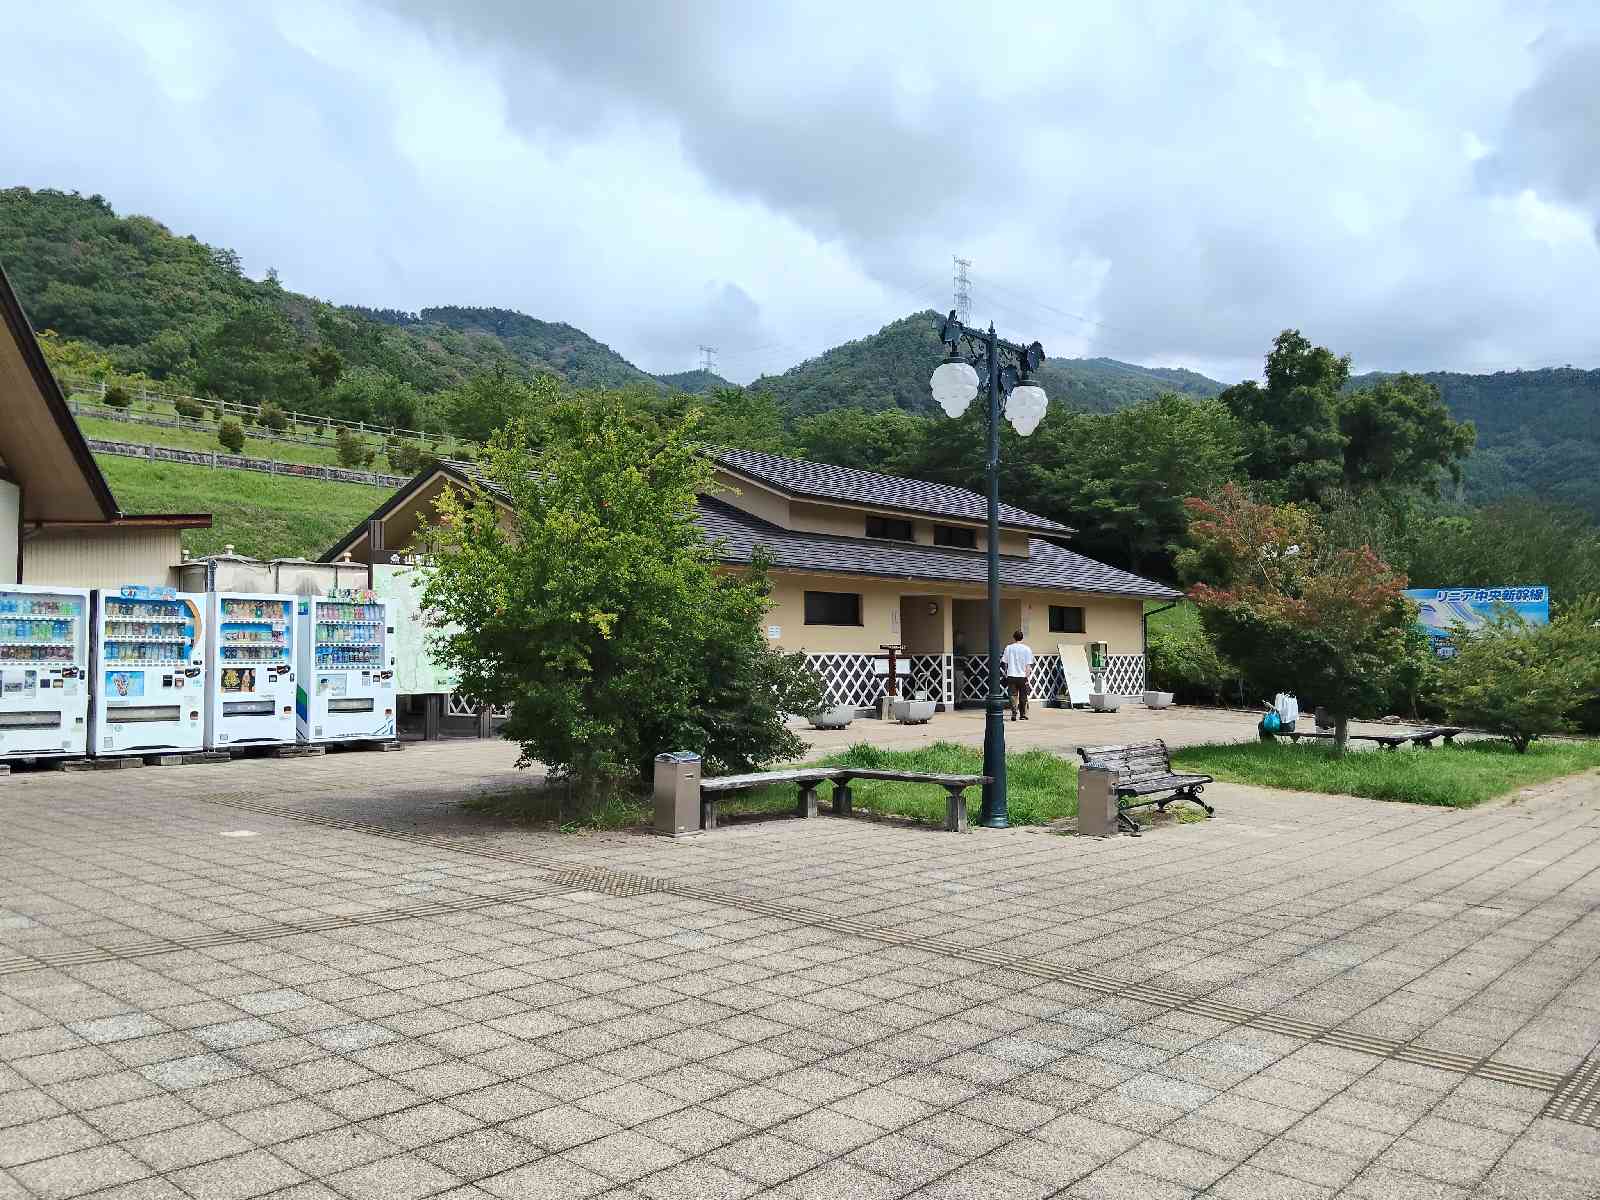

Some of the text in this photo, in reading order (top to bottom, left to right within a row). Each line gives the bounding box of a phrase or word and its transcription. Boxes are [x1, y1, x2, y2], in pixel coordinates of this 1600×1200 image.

[1438, 588, 1544, 603] リニア中央新幹線
